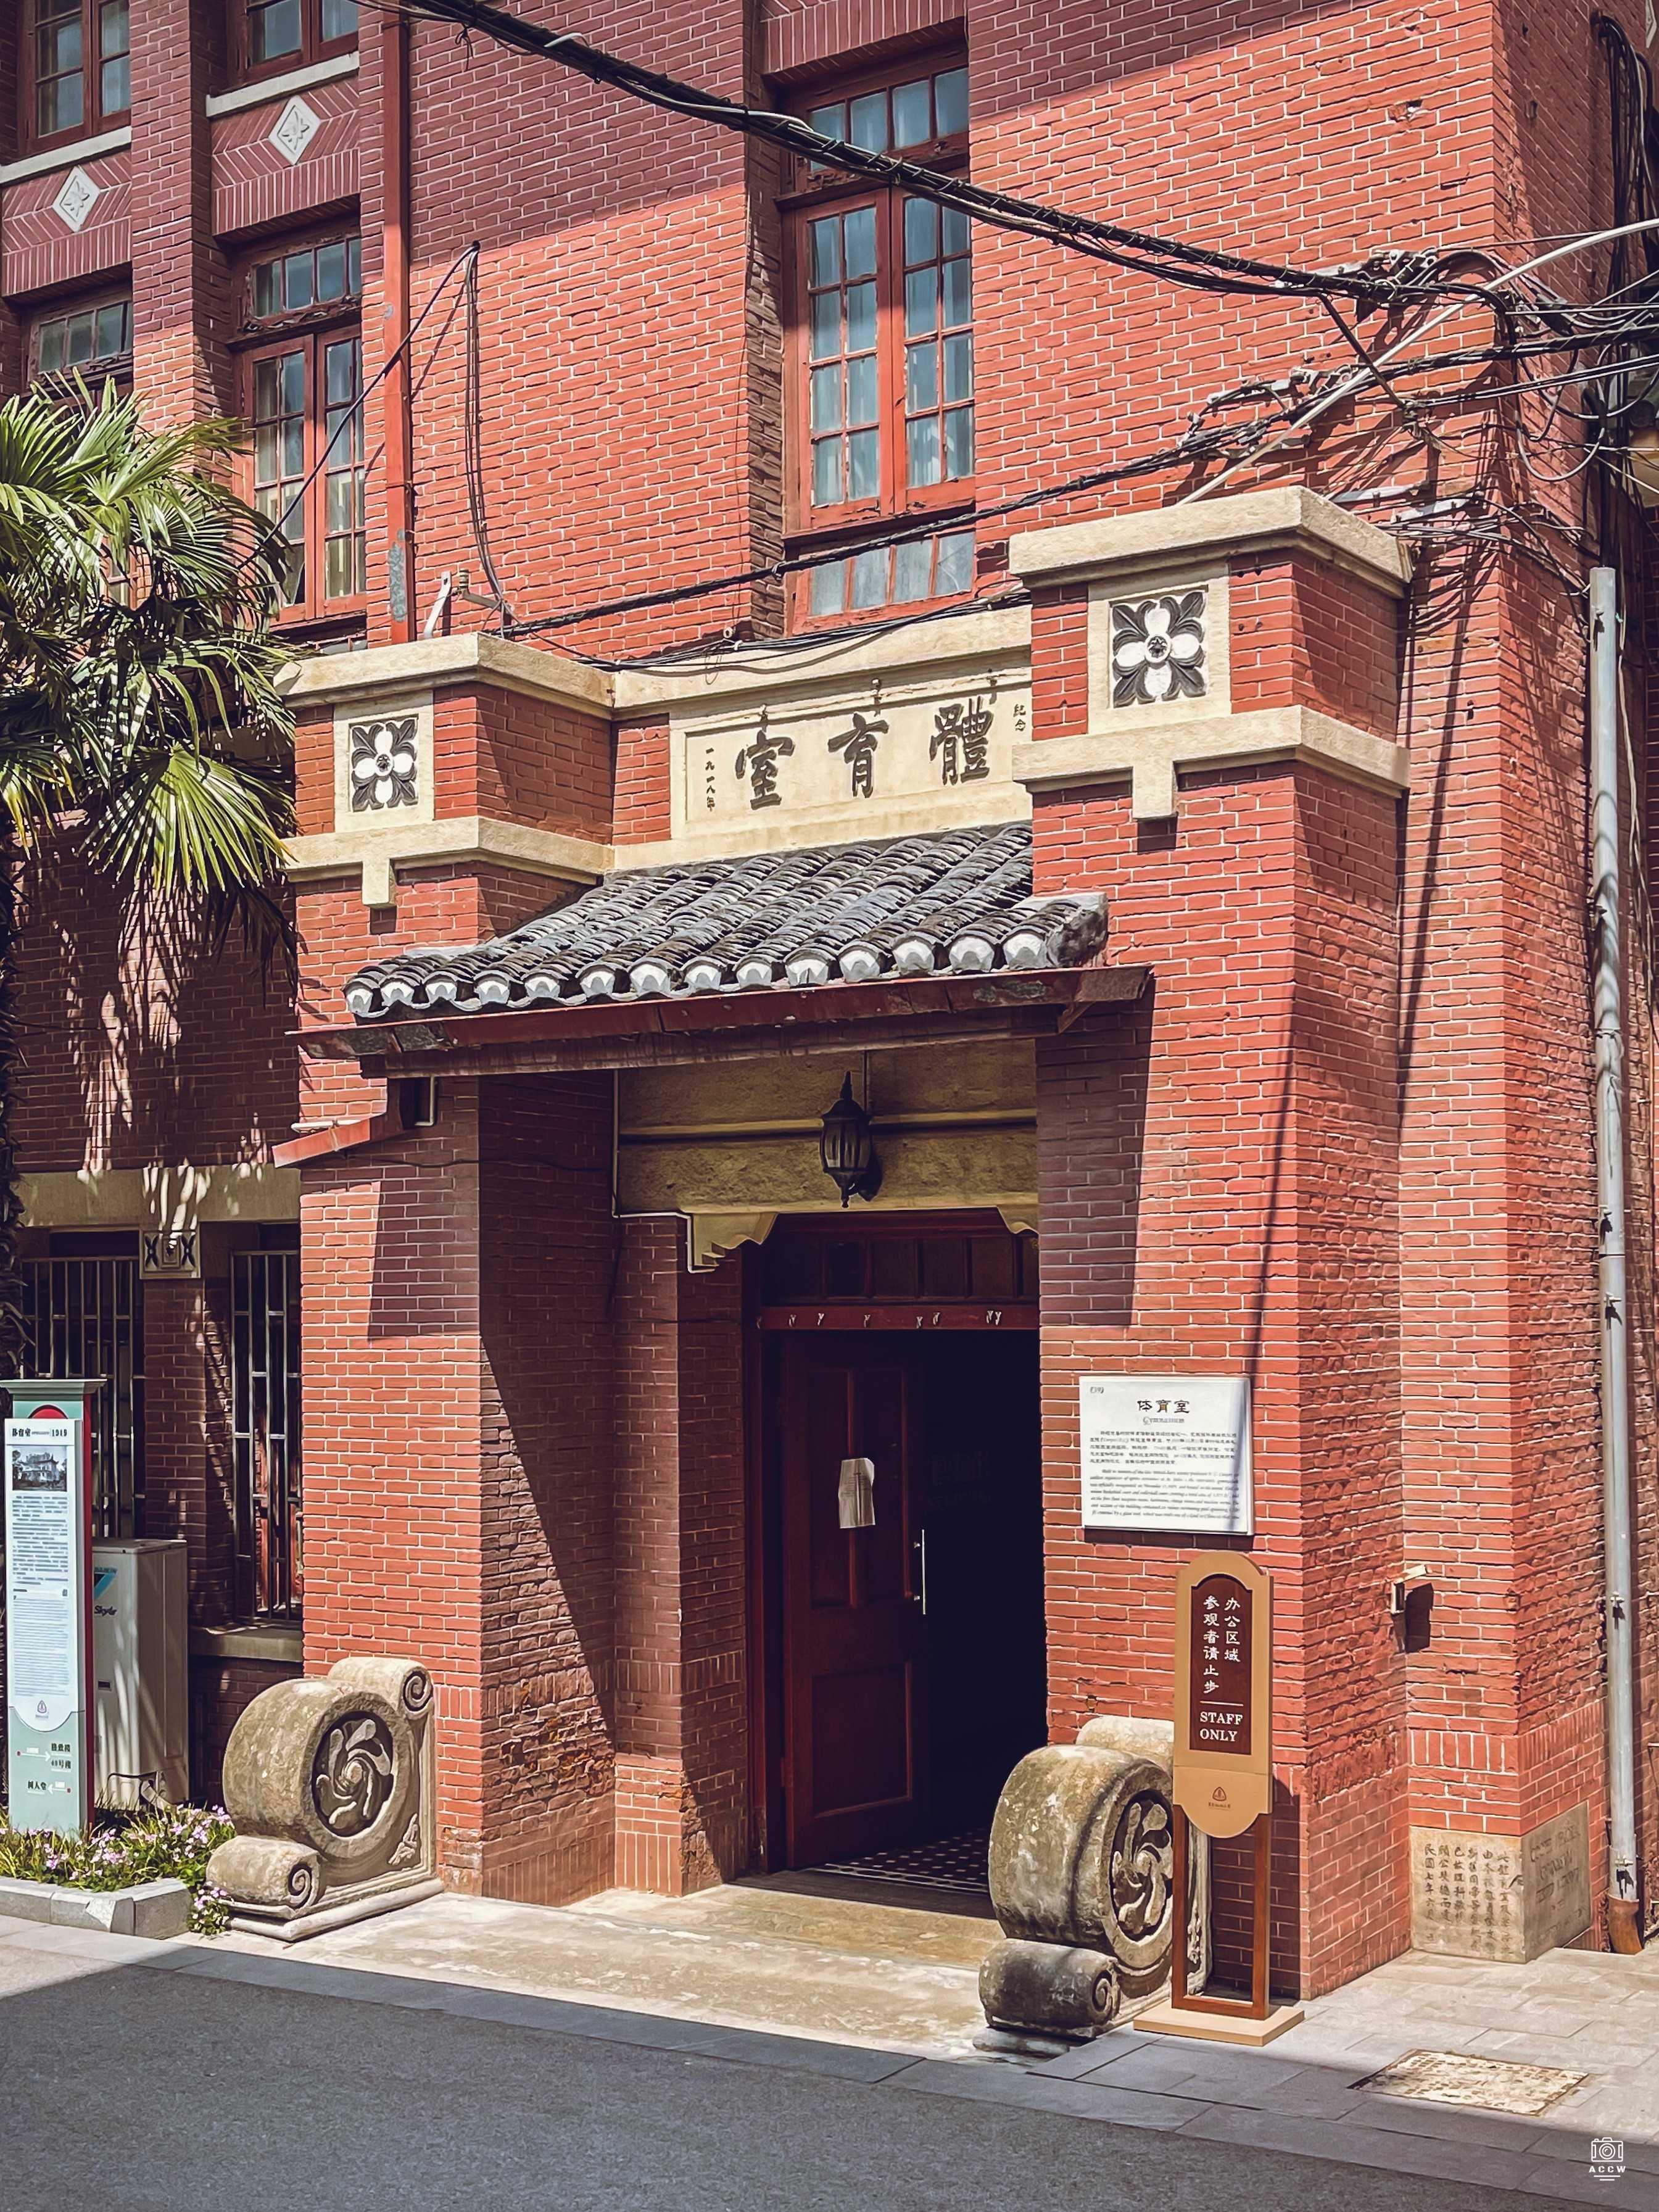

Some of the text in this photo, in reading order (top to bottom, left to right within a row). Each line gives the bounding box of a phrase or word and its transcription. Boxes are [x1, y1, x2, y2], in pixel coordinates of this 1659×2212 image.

[734, 695, 995, 811] 體育室
[1137, 1399, 1191, 1414] 体育室
[1202, 1594, 1220, 1694] 参观者请止步
[1223, 1596, 1241, 1662] 办公区域
[1199, 1711, 1243, 1726] STAFF
[1199, 1728, 1238, 1742] ONLY
